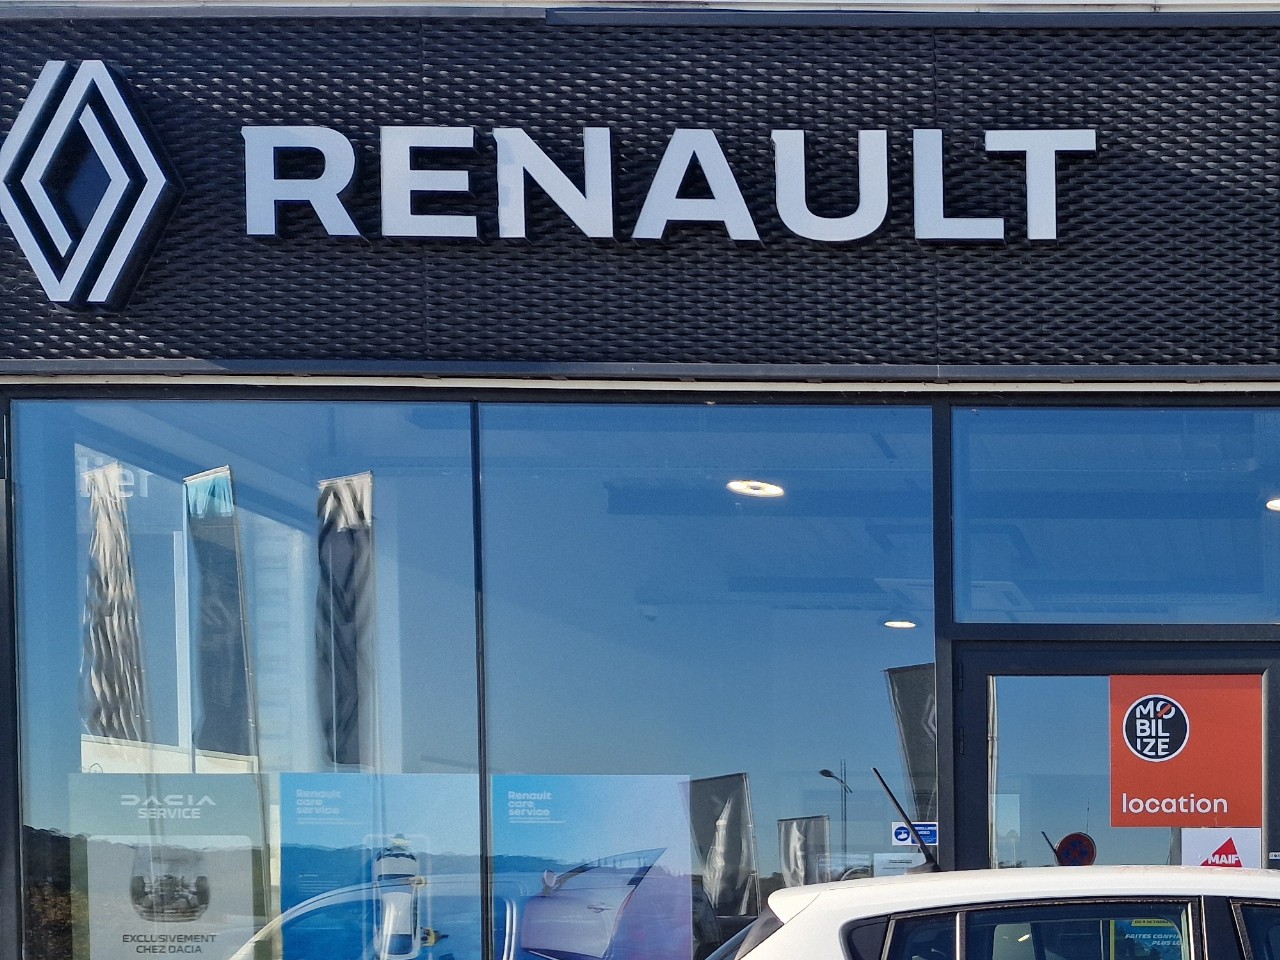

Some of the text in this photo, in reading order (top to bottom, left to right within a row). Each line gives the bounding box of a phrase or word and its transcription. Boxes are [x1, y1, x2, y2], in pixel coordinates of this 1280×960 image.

[242, 125, 1097, 243] RENAULT
[296, 789, 341, 798] Renault
[508, 791, 552, 800] Renault
[120, 794, 216, 806] DACIA
[296, 798, 323, 806] care
[508, 800, 534, 808] care
[1122, 792, 1228, 813] location
[138, 808, 201, 819] SERVICE
[296, 806, 340, 815] service
[508, 807, 550, 816] service
[1208, 853, 1239, 865] MAIF
[122, 934, 217, 943] EXCLUSIVEMENT
[136, 945, 202, 954] CHEZ DACIA
